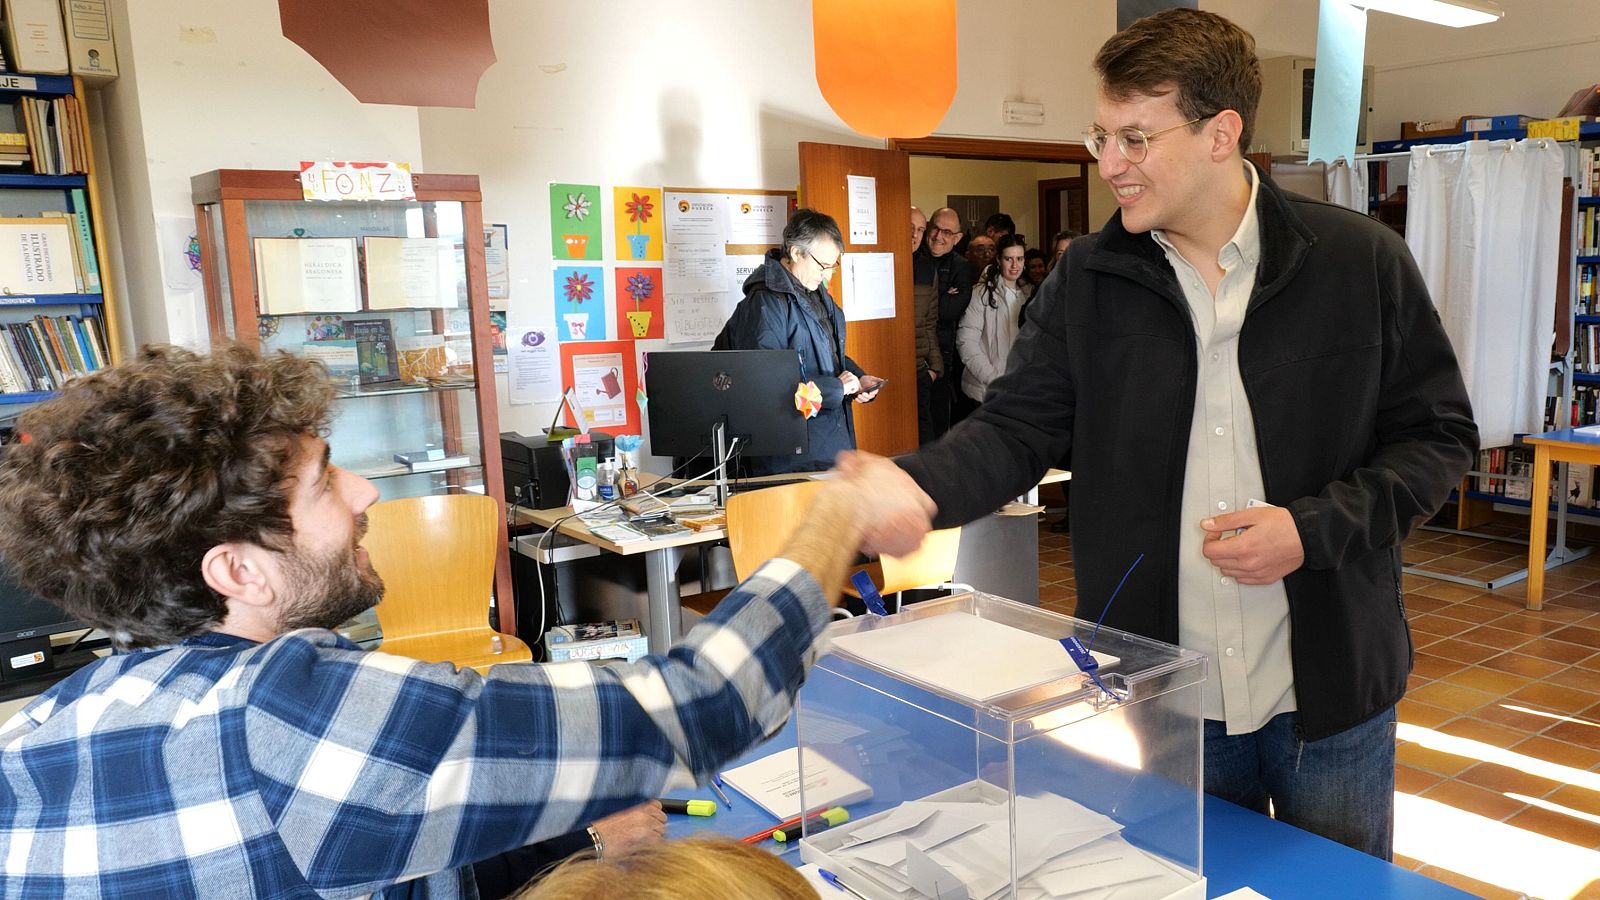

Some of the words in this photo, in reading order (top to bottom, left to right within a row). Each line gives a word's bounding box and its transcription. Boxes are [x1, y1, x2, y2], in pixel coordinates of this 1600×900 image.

[0, 77, 20, 88] JE
[321, 168, 396, 195] FONZ
[20, 233, 28, 243] DE
[22, 243, 30, 252] LA
[30, 233, 45, 282] ILUSTRADO
[23, 252, 34, 282] INFANCIA
[16, 630, 36, 638] acer
